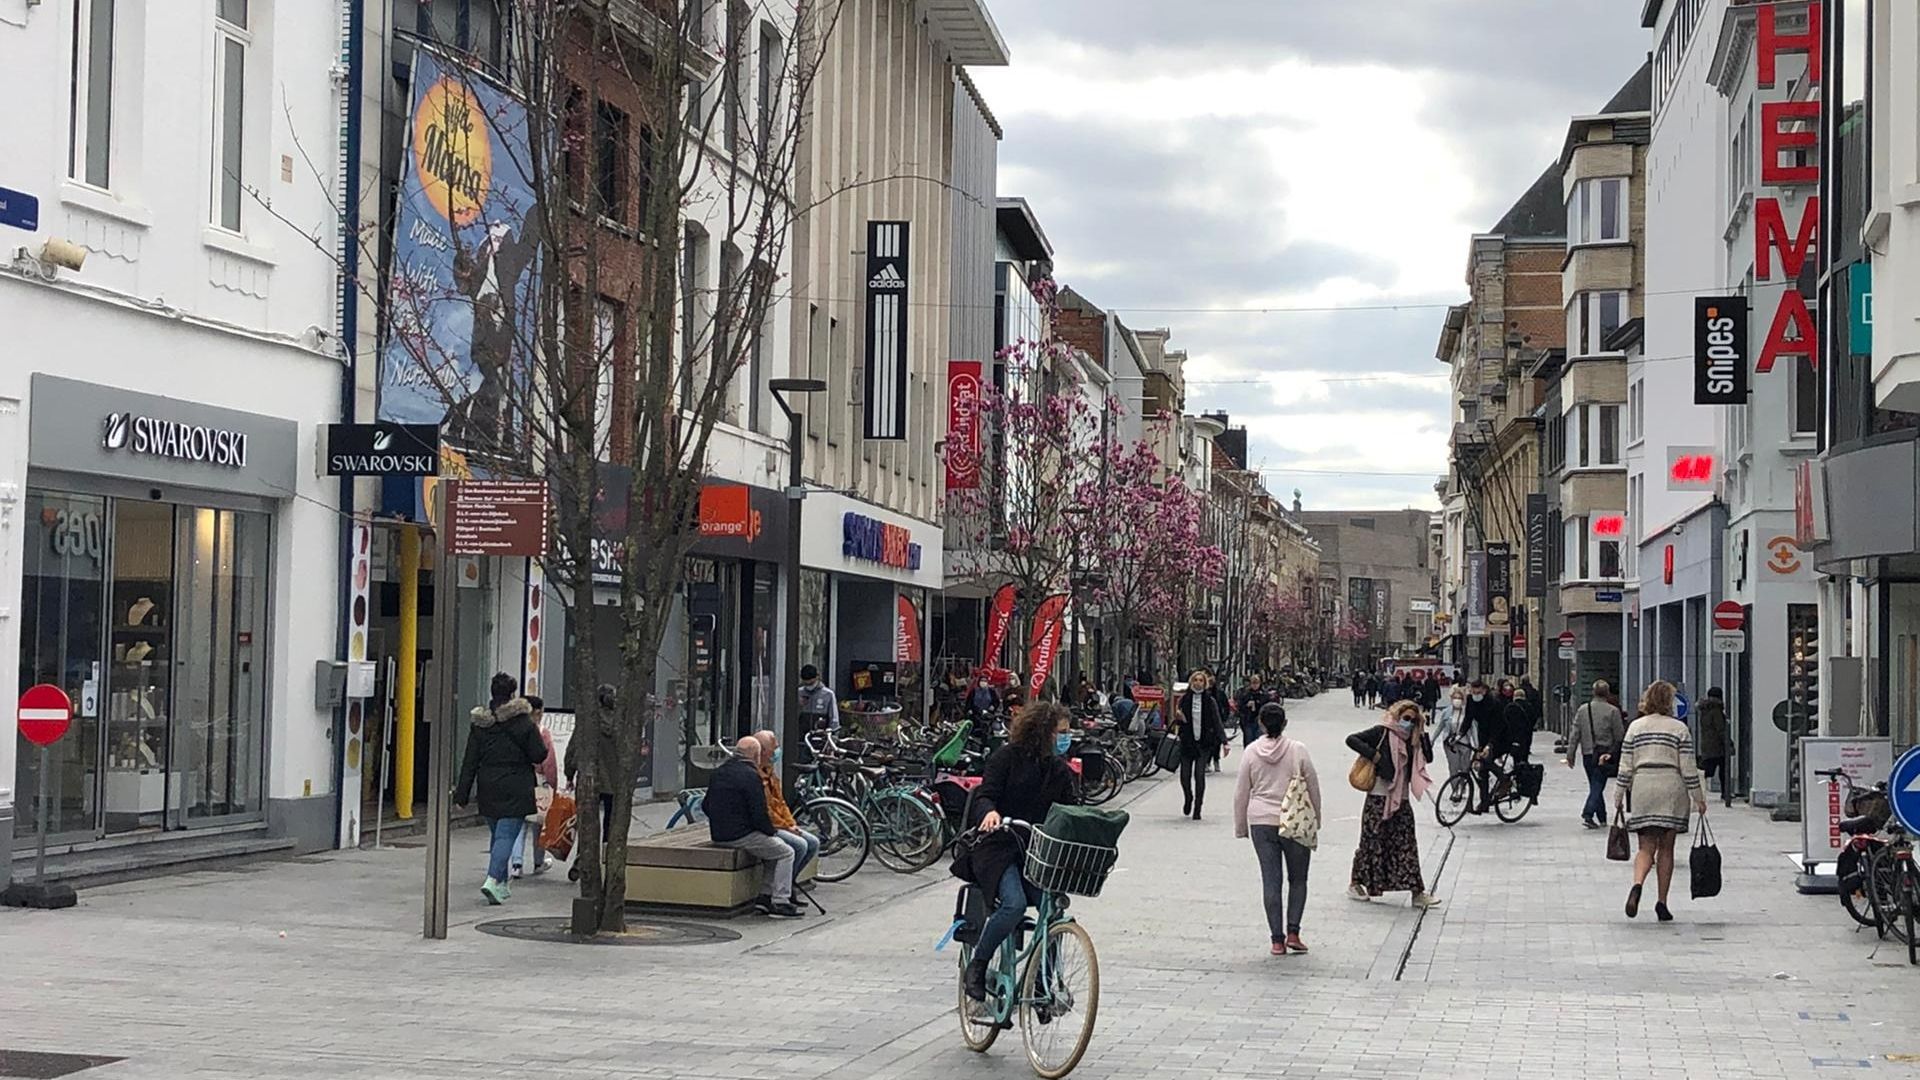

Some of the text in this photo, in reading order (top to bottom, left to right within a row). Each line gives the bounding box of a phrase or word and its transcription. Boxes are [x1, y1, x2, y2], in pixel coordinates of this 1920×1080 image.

[421, 123, 483, 201] Mama
[1755, 3, 1821, 374] HEMA
[869, 279, 906, 289] adidas
[1707, 317, 1740, 394] snipes
[134, 416, 249, 467] SWAROVSKI
[332, 455, 433, 472] SWAROVSKI
[702, 522, 742, 534] orange
